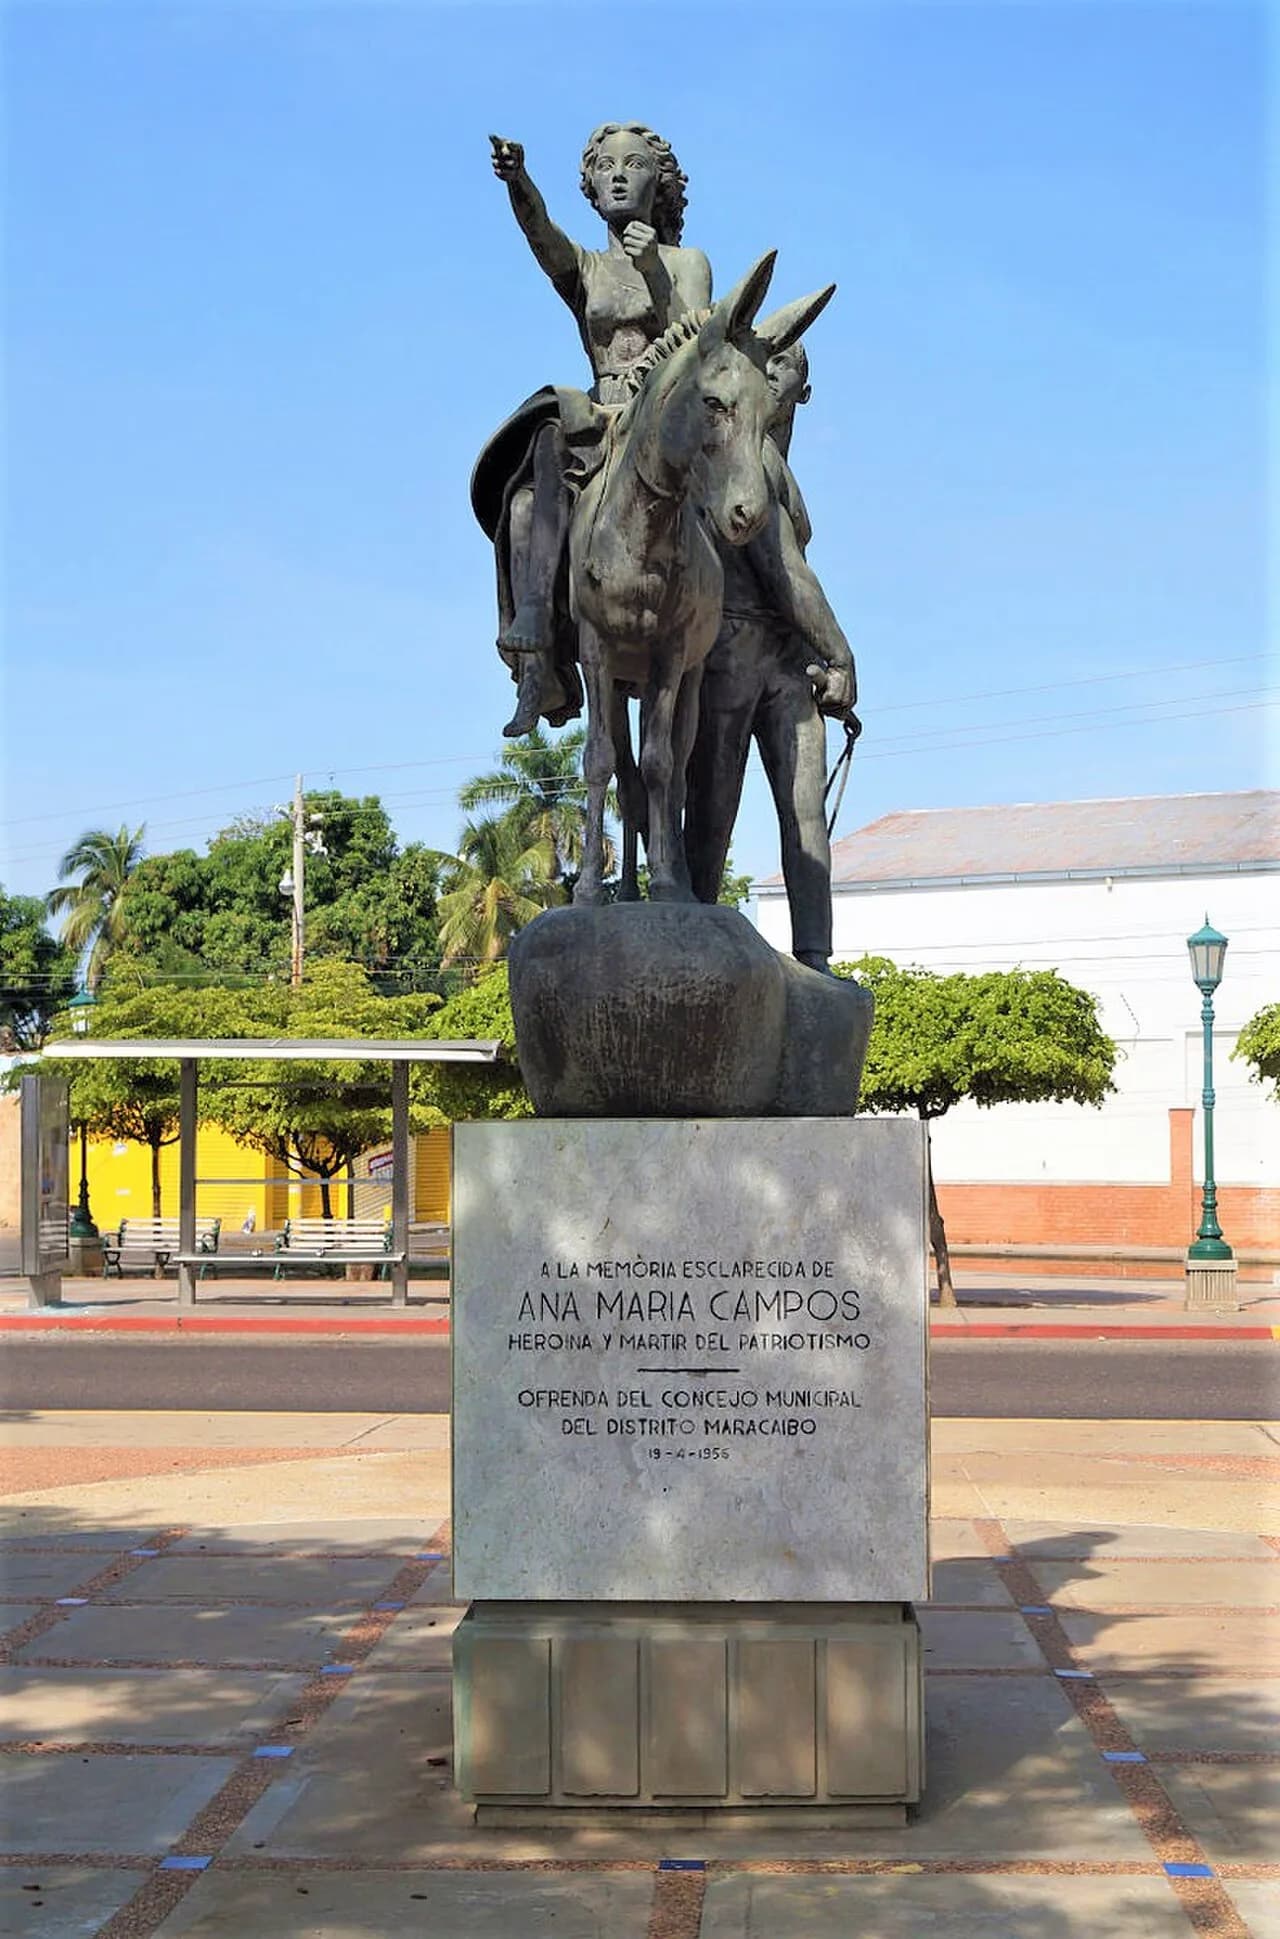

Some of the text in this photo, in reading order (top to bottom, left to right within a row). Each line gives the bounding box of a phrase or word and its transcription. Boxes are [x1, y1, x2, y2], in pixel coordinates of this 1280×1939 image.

[541, 1262, 550, 1278] A
[557, 1262, 580, 1278] LA
[683, 1261, 806, 1279] ESCLARECIDA
[813, 1261, 835, 1278] DE
[518, 1289, 860, 1322] ANA MARIA CAMPOS
[508, 1333, 871, 1350] HEROINA Y MARTIR DEL PATRIOTISMO
[518, 1390, 861, 1408] OFRENDA DEL CONCEJO MUNICIPAL
[562, 1418, 817, 1435] DEL DISTRITO MARACAIBO
